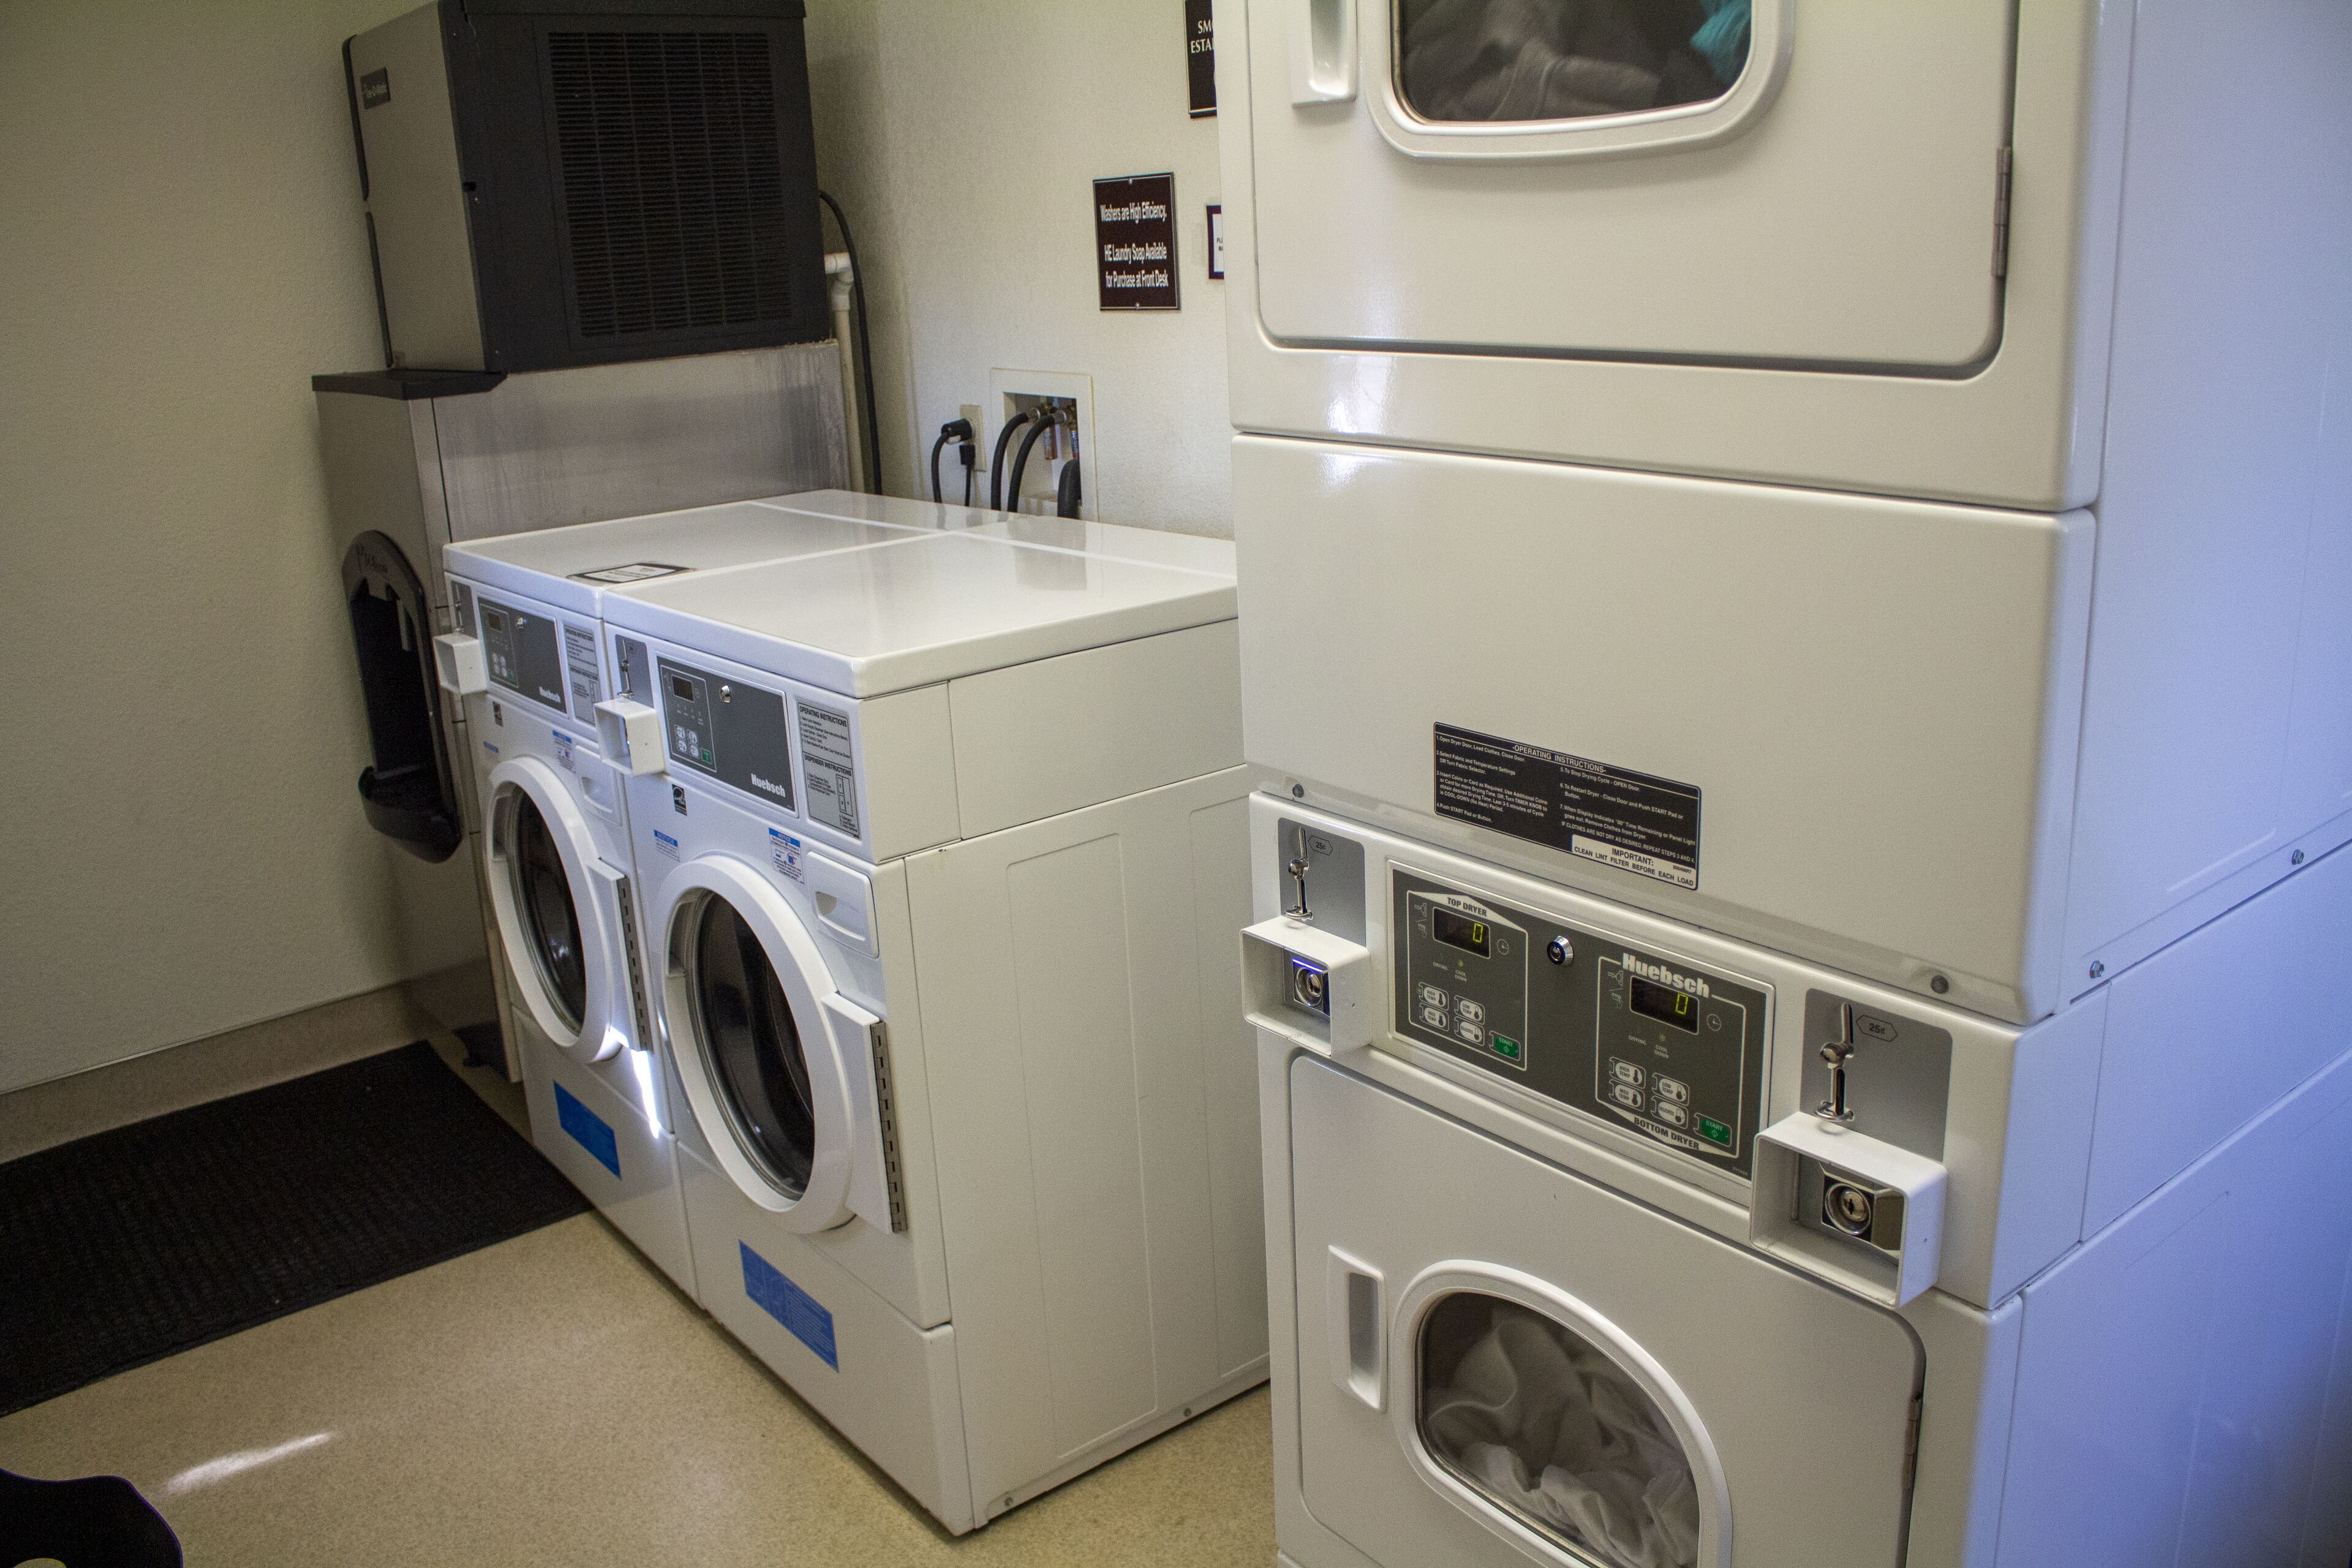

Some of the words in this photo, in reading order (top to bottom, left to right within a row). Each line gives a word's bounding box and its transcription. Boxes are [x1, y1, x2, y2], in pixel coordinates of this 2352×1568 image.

[1198, 20, 1212, 34] SM
[1100, 204, 1121, 221] Washers
[1129, 202, 1141, 224] High
[1104, 244, 1112, 262] HE
[1113, 243, 1132, 264] Laundry
[1132, 243, 1145, 264] Soap
[1145, 242, 1167, 260] Available
[1113, 270, 1136, 288] Purchase
[1136, 271, 1142, 287] at
[1142, 270, 1155, 287] Front
[1155, 269, 1169, 287] Desk
[799, 706, 820, 718] OPERATING
[820, 712, 847, 727] INSTRUCTIONS
[804, 754, 824, 766] DISPENSER
[824, 761, 851, 776] INSTRUCTIONS
[1473, 760, 1497, 771] Temperature
[751, 773, 786, 797] Huebsch
[1581, 772, 1596, 781] Drying
[1597, 776, 1610, 785] Cycle
[1444, 791, 1469, 802] COOL-DOWN
[1468, 791, 1480, 800] Drying
[1513, 791, 1534, 801] Additional
[1577, 809, 1593, 818] Display
[1594, 813, 1614, 823] Indicates
[1637, 825, 1662, 837] Remaining
[1683, 837, 1695, 846] Light
[1585, 818, 1602, 827] Remove
[1604, 823, 1620, 832] Clothes
[1633, 832, 1646, 840] Dryer.
[1566, 823, 1585, 832] CLOTHES
[1643, 844, 1660, 853] REPEAT
[1574, 846, 1593, 856] CLEAN
[1610, 857, 1629, 867] FILTER
[1632, 863, 1655, 875] BEFORE
[1658, 870, 1674, 880] EACH
[1677, 876, 1694, 886] LOAD
[1611, 848, 1654, 865] IMPORTANT:
[1447, 897, 1461, 907] TOP
[1463, 902, 1487, 917] DRYER
[1472, 923, 1483, 943] 0
[1433, 961, 1448, 970] DRYING
[1623, 952, 1709, 998] Huebsch
[1676, 993, 1689, 1015] 0
[1498, 1038, 1513, 1047] START
[1629, 1035, 1646, 1045] DRYING
[1656, 1044, 1668, 1053] COOL
[1654, 1050, 1669, 1059] DOWN
[1634, 1117, 1668, 1137] BOTTOM
[1671, 1131, 1699, 1150] DRYER
[1705, 1120, 1723, 1131] START
